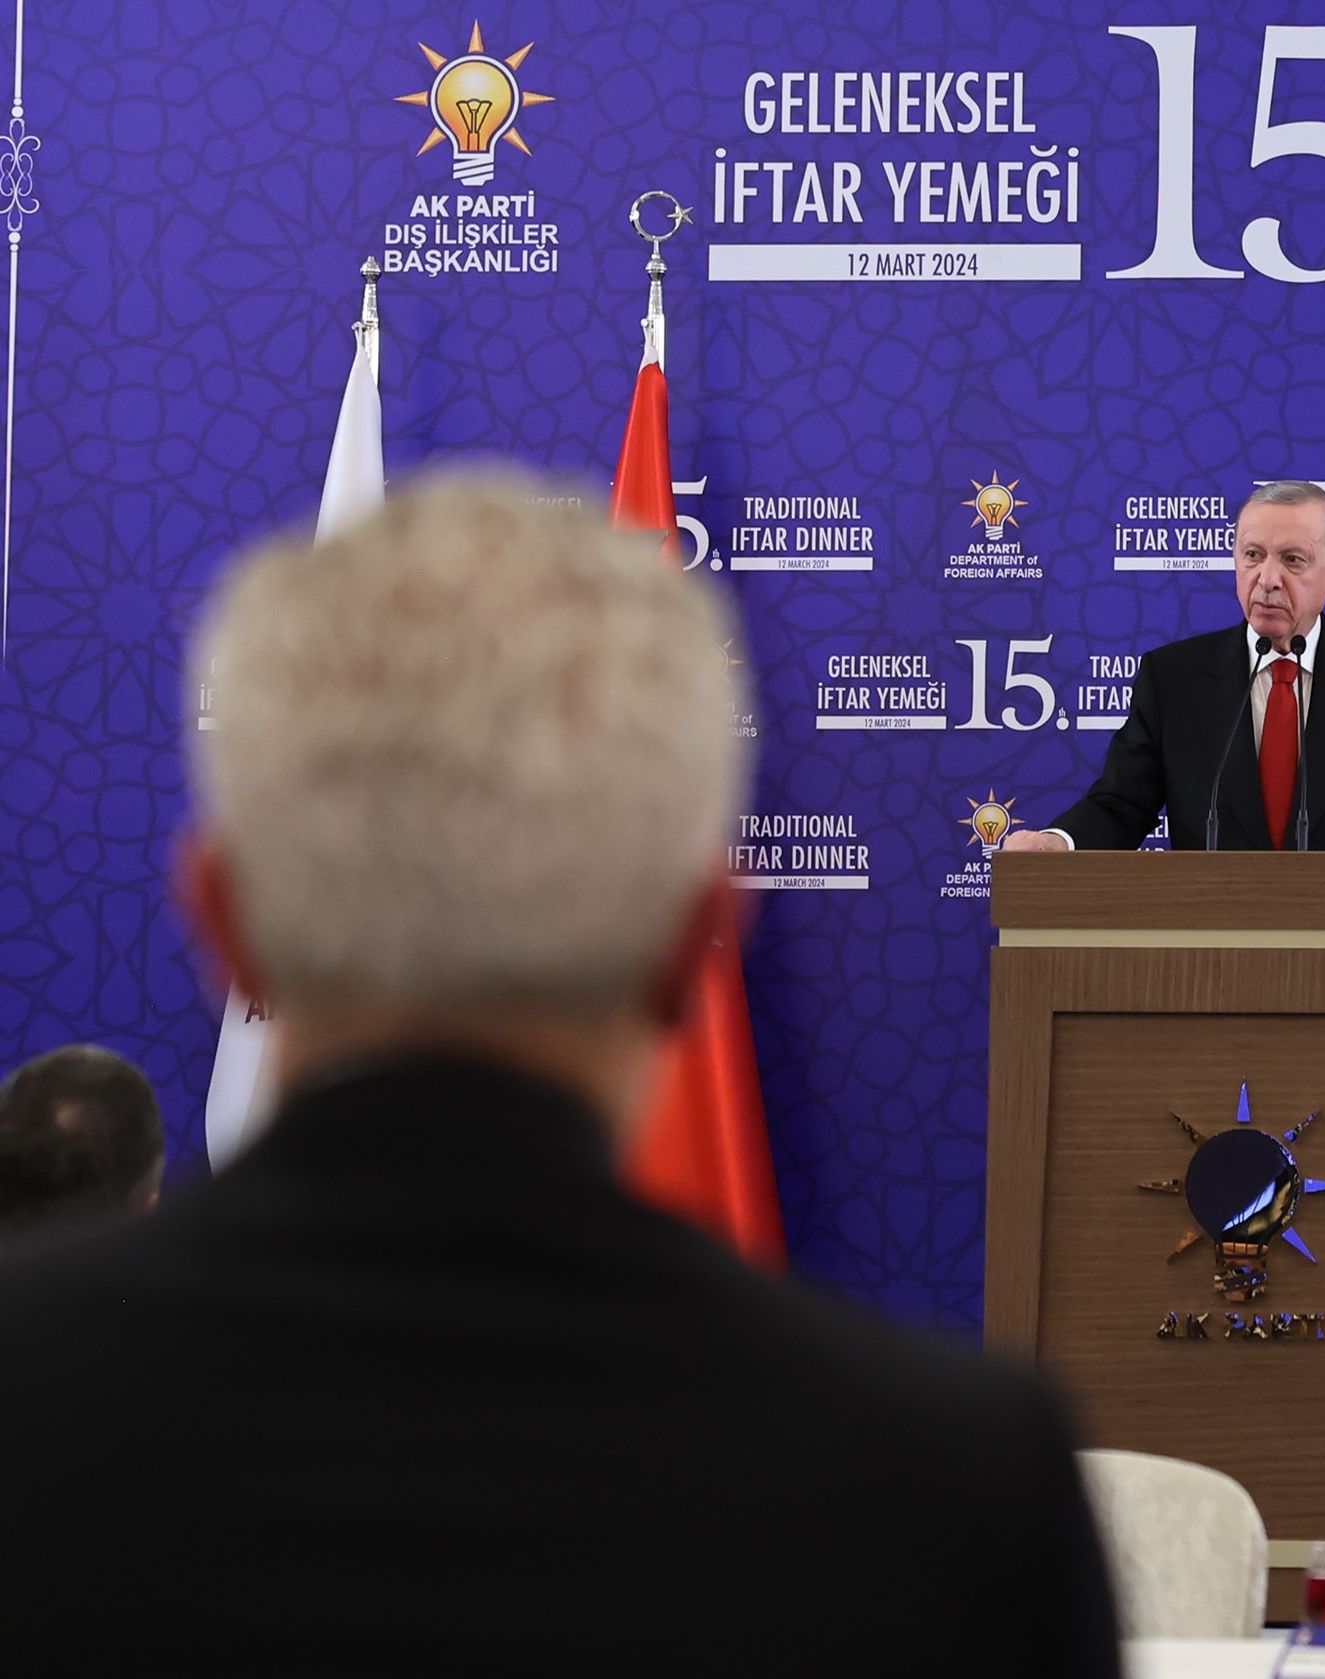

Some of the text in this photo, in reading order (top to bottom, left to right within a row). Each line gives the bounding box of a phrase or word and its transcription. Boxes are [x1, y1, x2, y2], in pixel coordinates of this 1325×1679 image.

[744, 71, 1036, 134] GELENEKSEL
[714, 144, 1079, 223] İFTAR YEMEĞİ
[409, 190, 535, 218] AK PARTİ
[385, 218, 559, 250] DIŞ İLİŞKİLER
[384, 242, 558, 277] BAŞKANLIĞI
[848, 253, 978, 277] 12 MART 2024
[743, 496, 861, 520] TRADITIONAL
[1126, 496, 1229, 520] GELENEKSEL
[732, 526, 873, 551] IFTAR DINNER
[967, 541, 1021, 554] AK PARTİ
[1115, 523, 1236, 551] İFTAR YEMEĞ
[777, 558, 830, 570] 12 MARCH 2024
[950, 555, 1038, 566] DEPARTMENT of
[1162, 558, 1209, 570] 12 MART 2024
[944, 567, 1043, 579] FOREIGN AFFAIRS
[828, 655, 931, 678] GELENEKSEL
[817, 681, 946, 710] İFTAR YEMEĞİ
[1078, 686, 1133, 710] IFTAR
[864, 718, 911, 728] 12 MART 2024
[739, 815, 857, 838] TRADITIONAL
[728, 845, 869, 870] IFTAR DINNER
[964, 862, 981, 873] AK
[774, 878, 825, 888] 12 MARCH 2024
[946, 874, 991, 884] DEPART
[940, 887, 990, 897] FOREIGN
